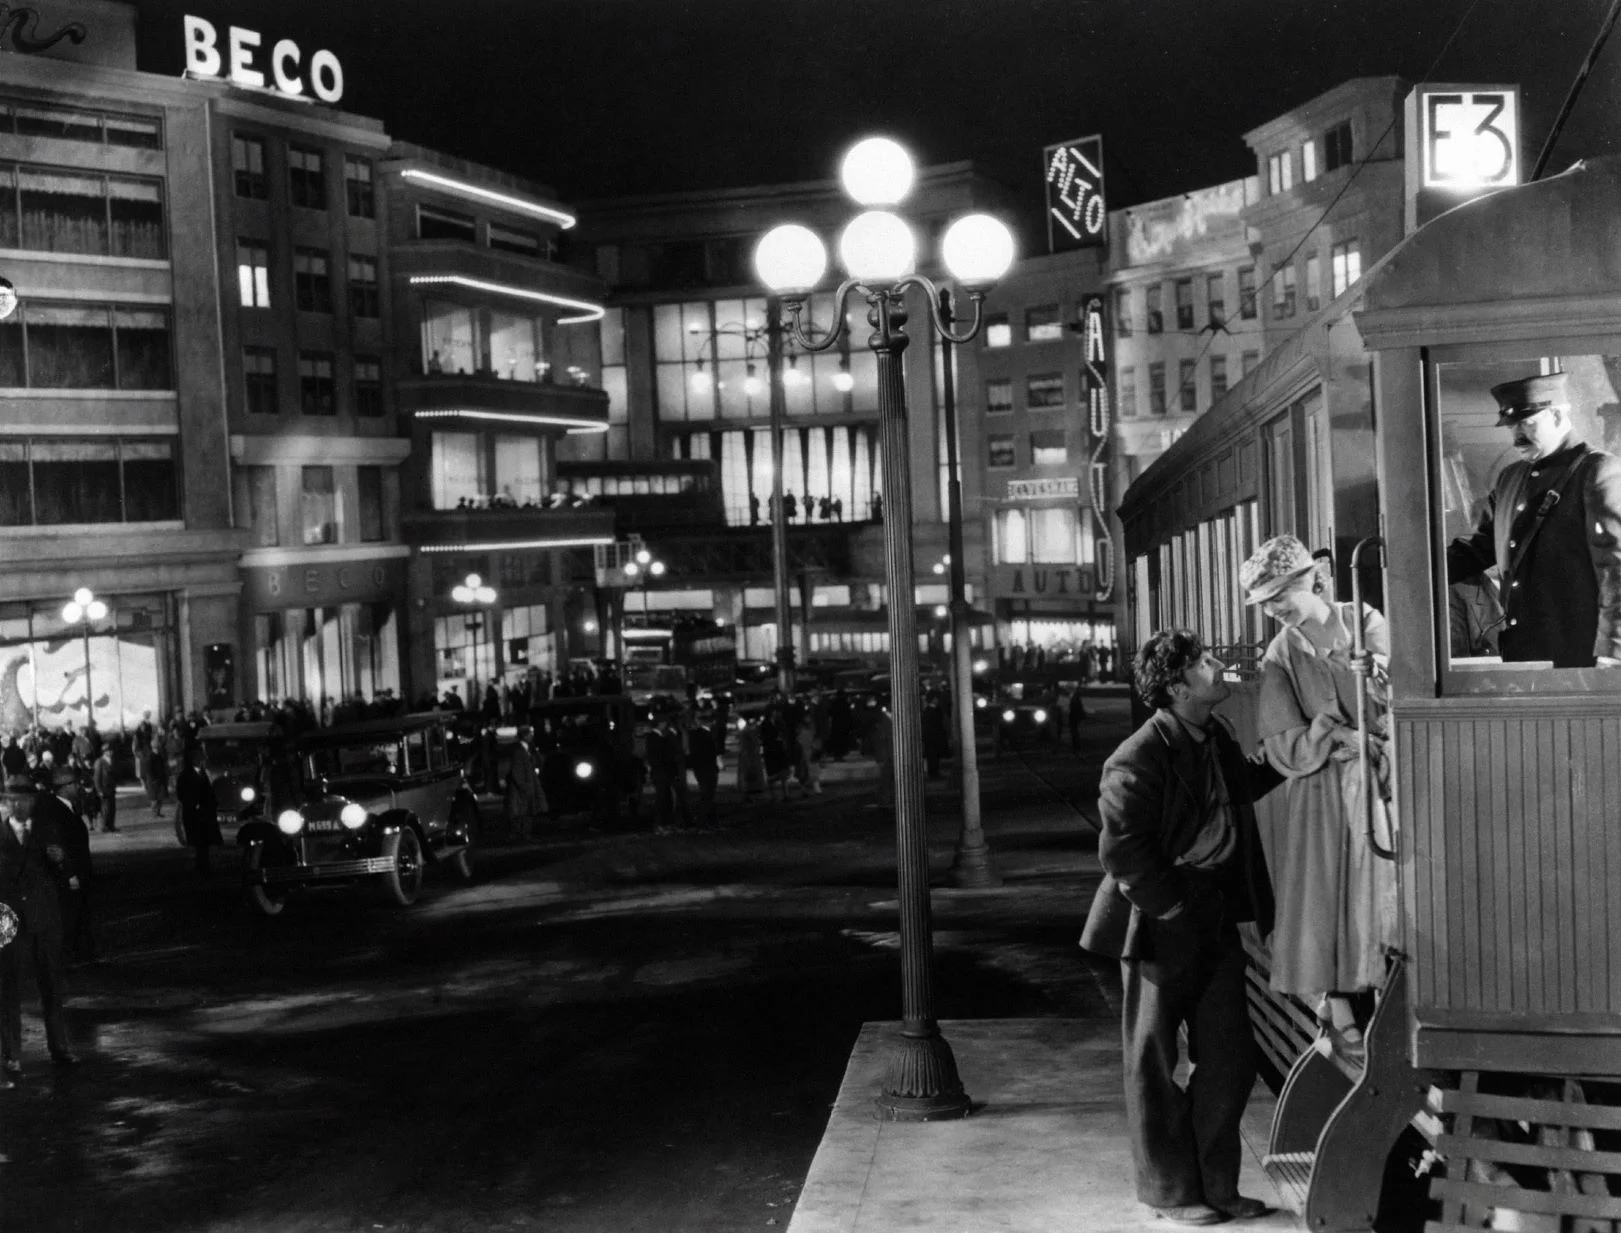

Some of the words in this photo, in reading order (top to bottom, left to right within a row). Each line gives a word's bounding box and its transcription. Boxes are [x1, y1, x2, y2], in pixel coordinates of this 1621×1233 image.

[184, 14, 343, 103] BECO
[1427, 94, 1513, 183] E3
[1089, 311, 1112, 587] AUTO
[268, 566, 385, 596] BECO
[1012, 568, 1093, 595] AUTO
